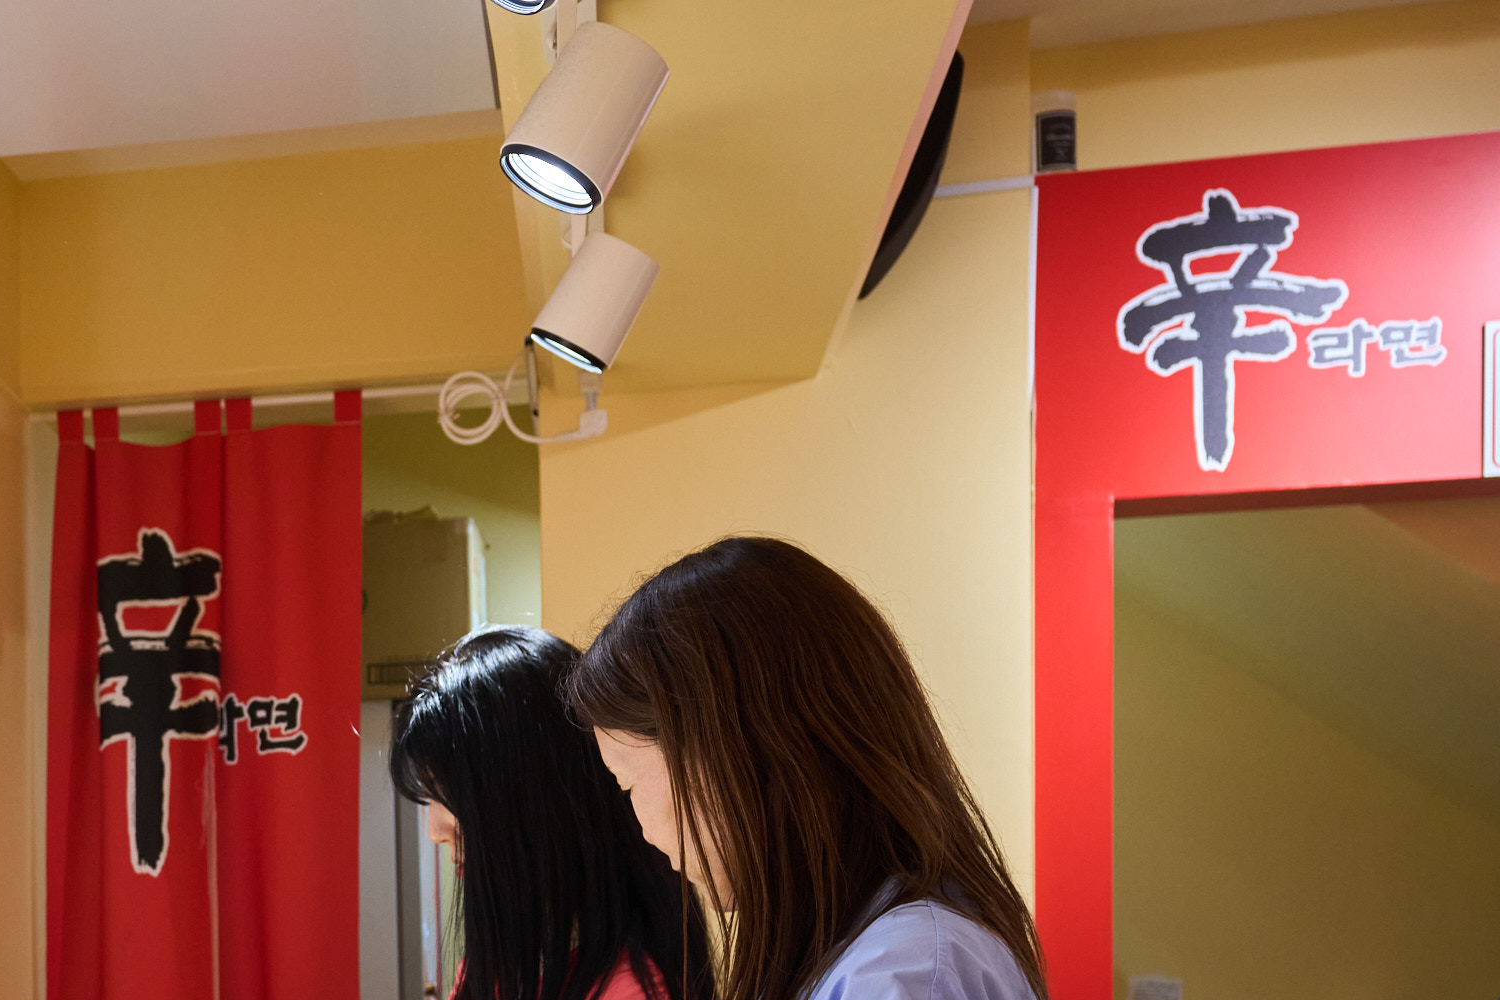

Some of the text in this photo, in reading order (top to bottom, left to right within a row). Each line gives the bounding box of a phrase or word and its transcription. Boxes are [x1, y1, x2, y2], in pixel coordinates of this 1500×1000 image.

[1117, 188, 1349, 472] 辛
[1306, 317, 1448, 377] 라면
[95, 527, 223, 877] 辛
